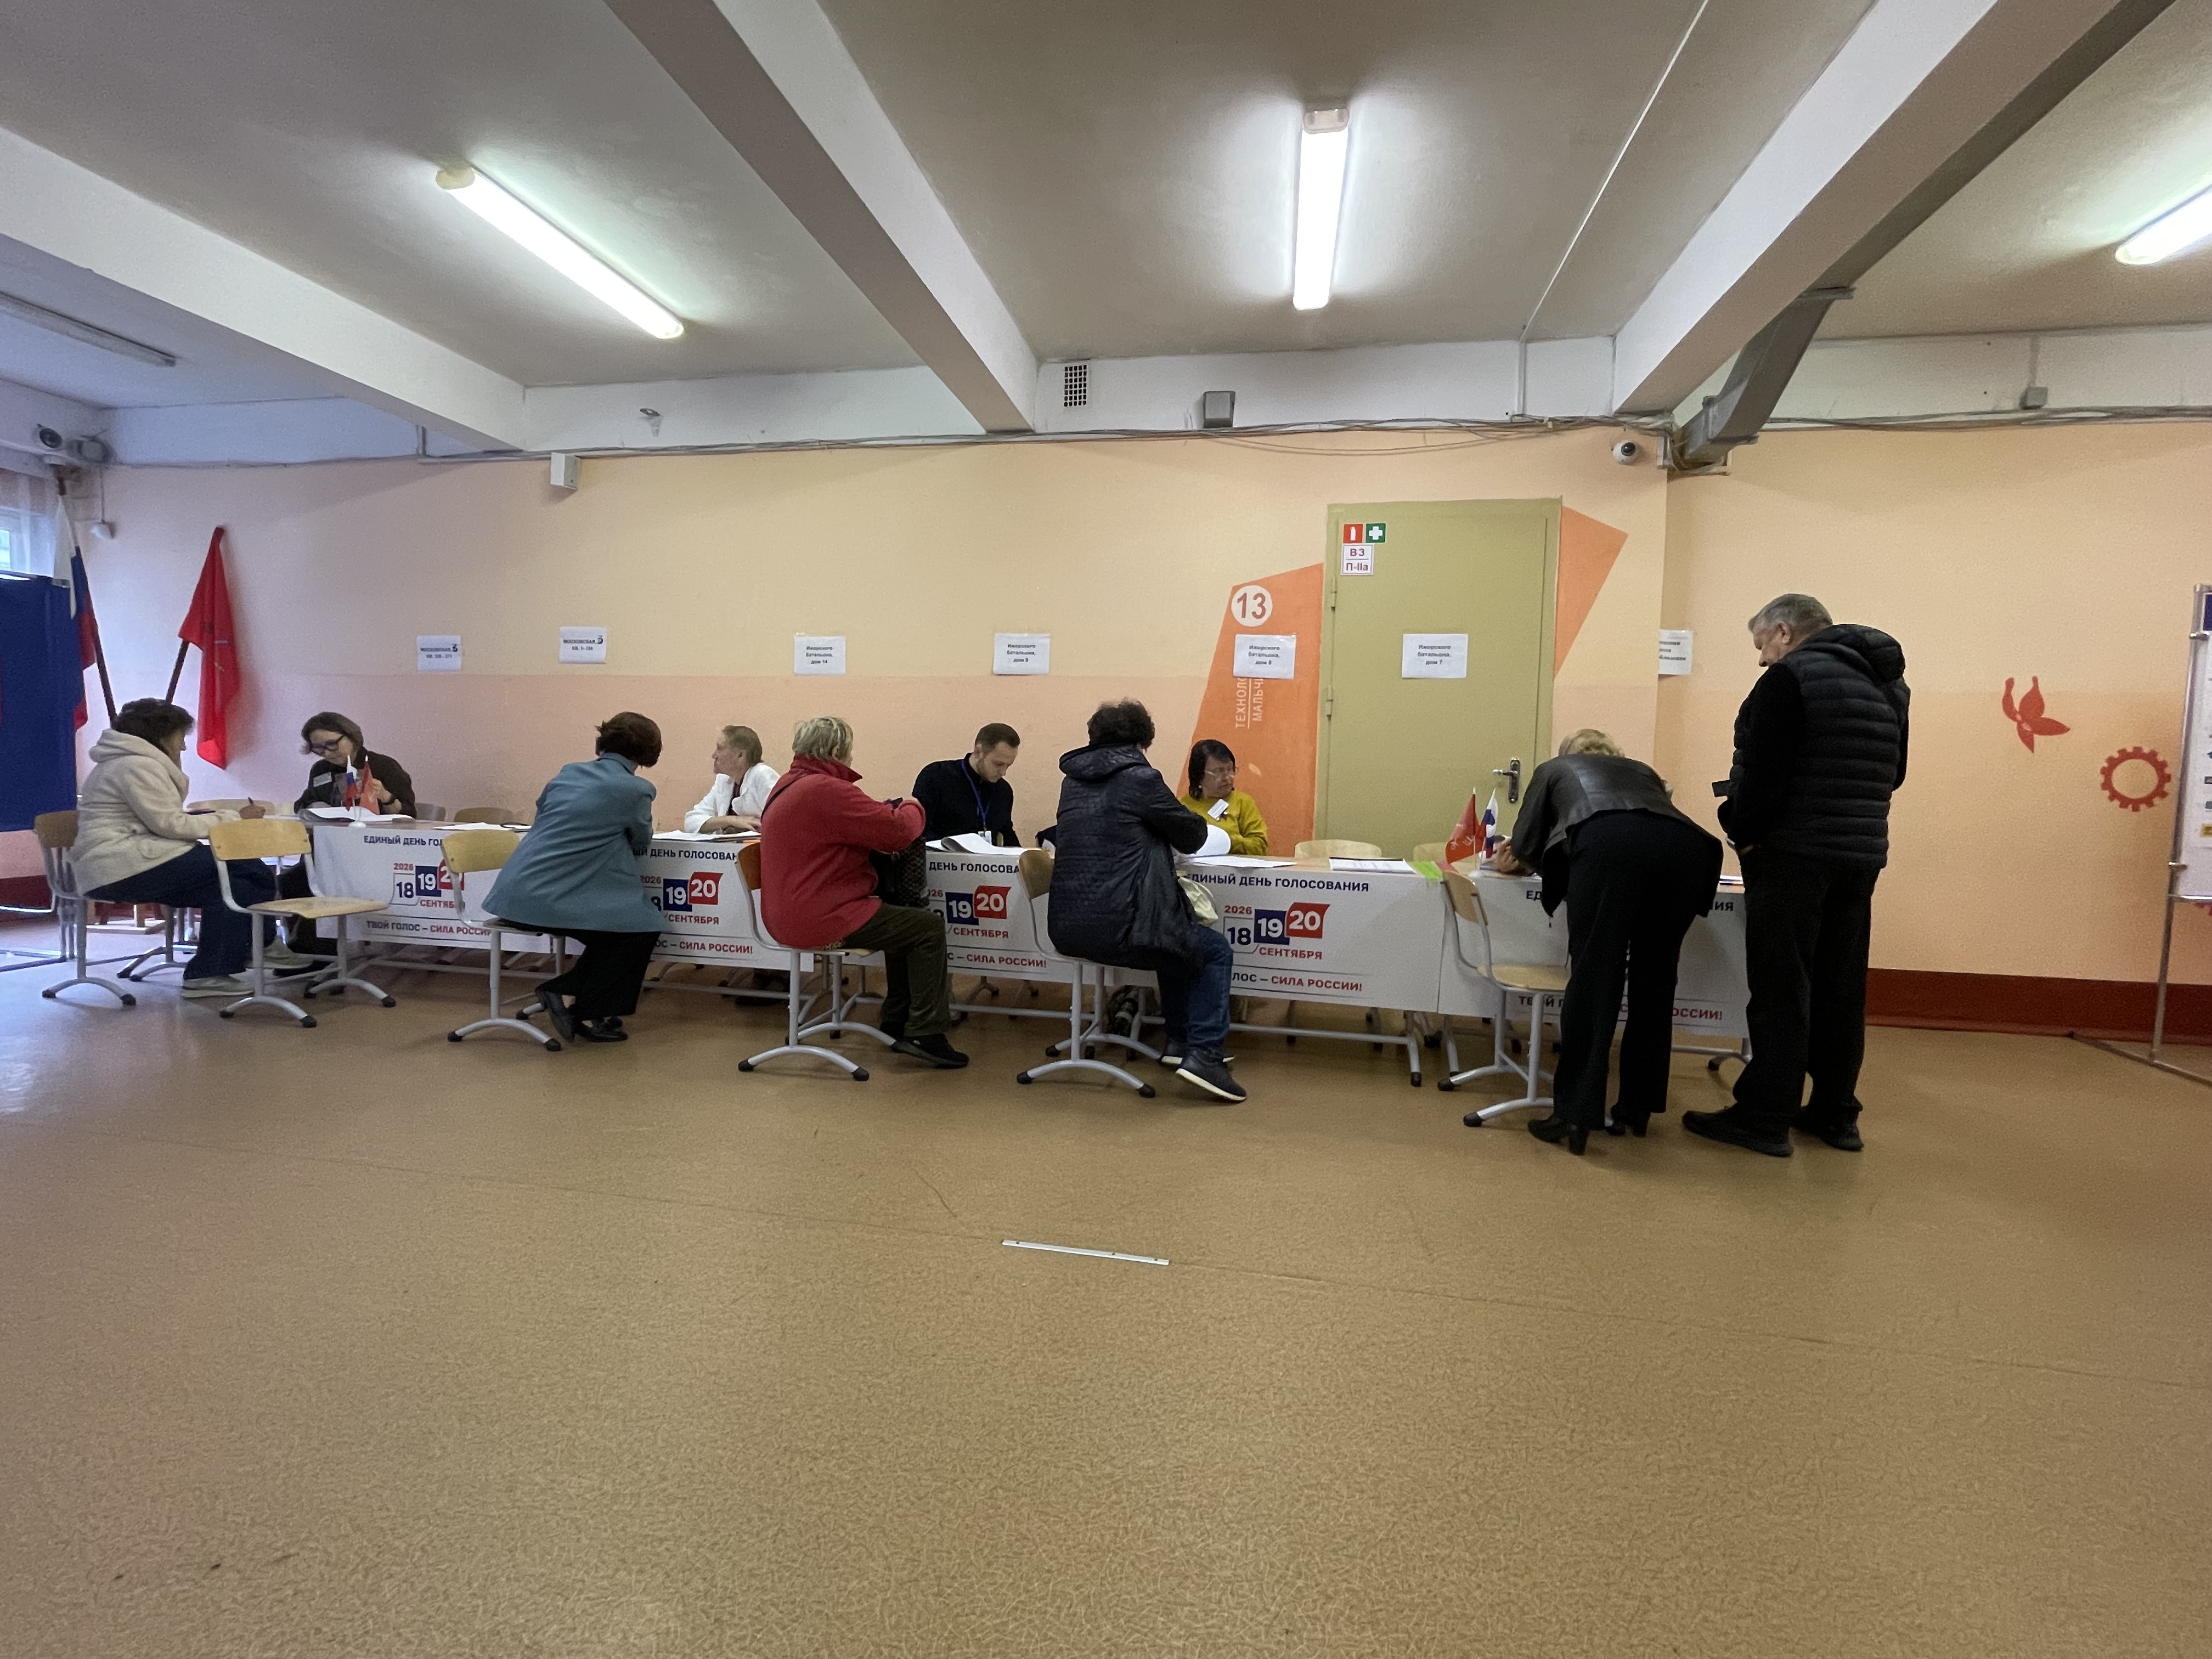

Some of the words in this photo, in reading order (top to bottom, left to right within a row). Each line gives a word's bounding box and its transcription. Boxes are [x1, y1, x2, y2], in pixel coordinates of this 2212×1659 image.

[1237, 592, 1266, 619] 13
[364, 834, 401, 844] ЕДИНЫЙ
[403, 837, 426, 846] ДЕНЬ
[650, 849, 676, 858] ДЕНЬ
[678, 850, 737, 861] ГОЛОСОВА
[393, 862, 414, 871] 2026
[929, 861, 958, 871] ДЕНЬ
[961, 862, 1019, 873] ГОЛОСОВА
[396, 881, 414, 899] 18
[417, 873, 436, 891] 19
[1239, 876, 1272, 888] ДЕНЬ
[1275, 878, 1369, 893] ГОЛОСОВАНИЯ
[665, 886, 686, 905] 19
[691, 879, 716, 898] 20
[420, 899, 461, 909] СЕНТЯБ
[948, 899, 972, 918] 19
[976, 893, 1004, 912] 20
[1224, 905, 1252, 915] 2026
[668, 914, 719, 925] СЕНТЯБРЯ
[391, 923, 420, 932] ГОЛОС
[430, 925, 454, 934] СИЛА
[953, 927, 1009, 939] СЕНТЯБРЯ
[1227, 927, 1251, 946] 18
[1257, 917, 1283, 938] 19
[1289, 911, 1321, 930] 20
[679, 941, 706, 951] СИЛА
[709, 943, 753, 954] РОССИИ!
[1259, 947, 1322, 960] СЕНТЯБРЯ
[967, 953, 996, 965] СИЛА
[999, 957, 1047, 968] РОССИИ!
[1232, 973, 1257, 983] ЛОС
[1271, 975, 1304, 987] СИЛА
[1308, 979, 1363, 992] РОССИИ!
[1673, 1007, 1723, 1020] ОССИИ!
